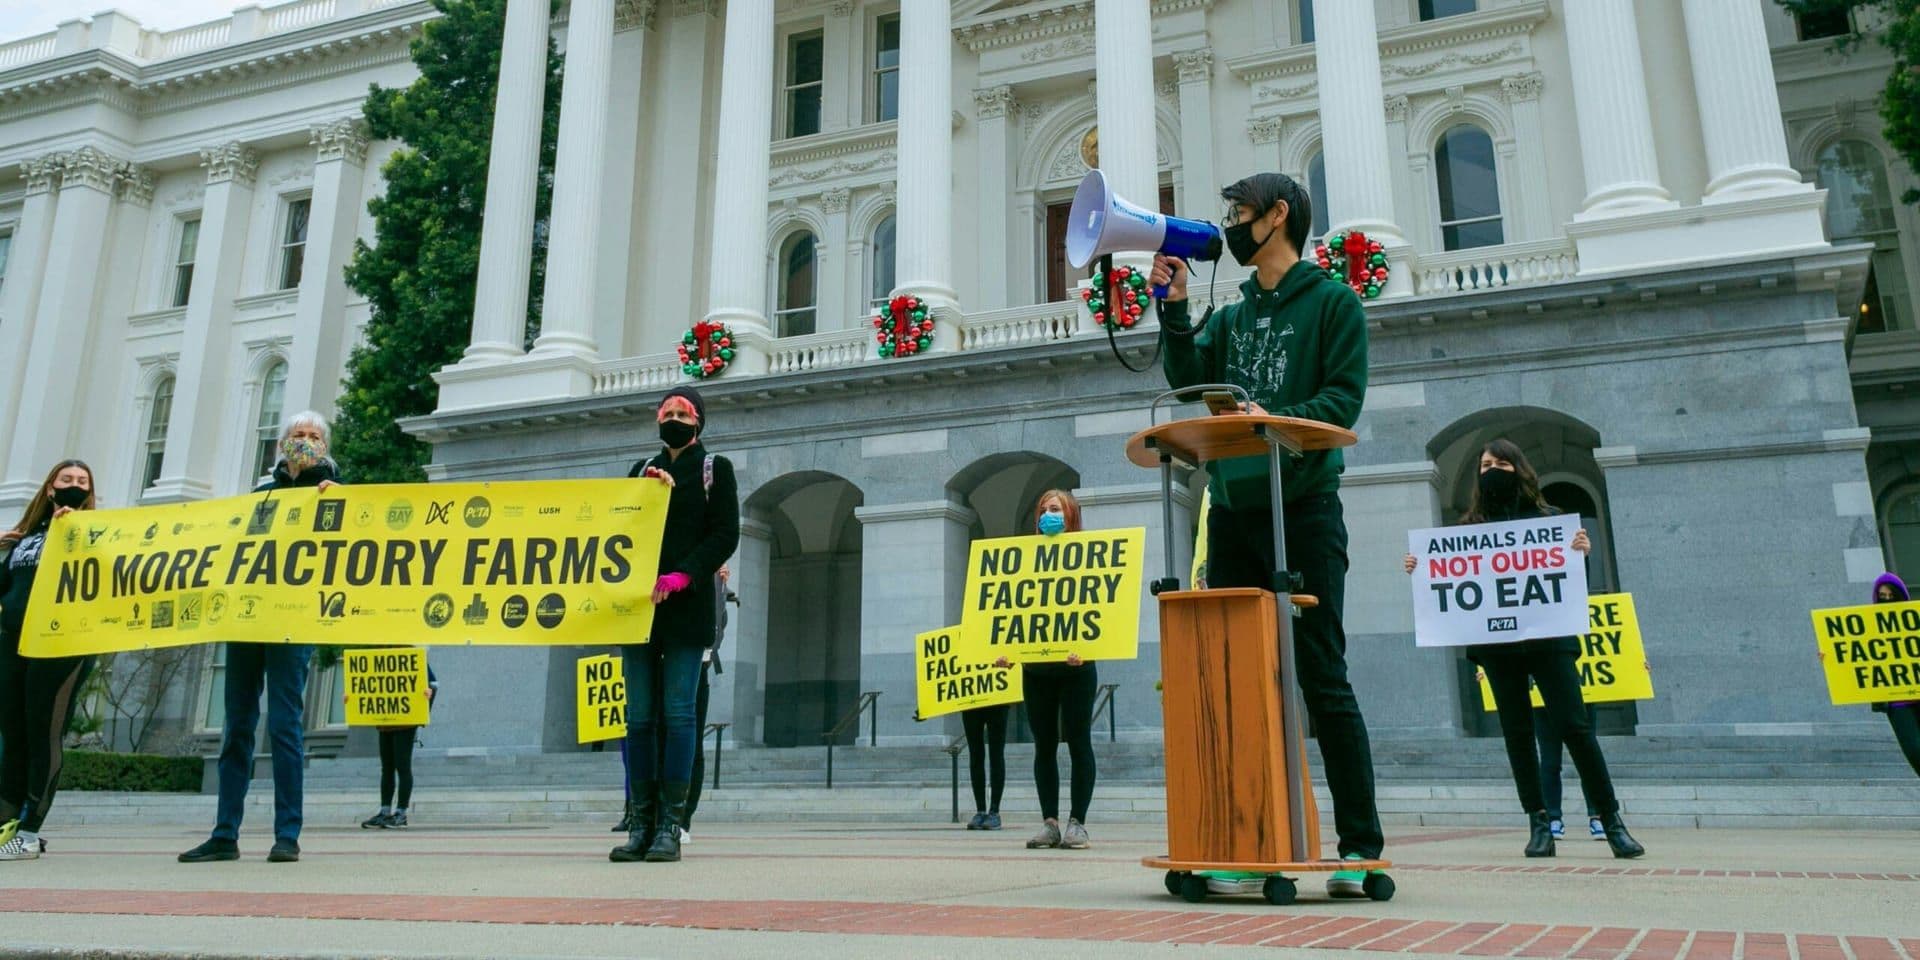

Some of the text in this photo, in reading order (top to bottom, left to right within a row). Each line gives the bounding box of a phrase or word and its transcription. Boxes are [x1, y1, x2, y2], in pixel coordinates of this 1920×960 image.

[538, 506, 561, 515] LUSH
[1427, 526, 1564, 554] ANIMALS ARE
[55, 534, 633, 604] NO MORE FACTORY FARMS
[980, 539, 1129, 577] NO MORE
[1429, 547, 1566, 578] NOT OURS
[978, 573, 1123, 611] FACTORY
[1430, 572, 1567, 613] TO EAT
[990, 610, 1101, 645] FARMS
[1825, 609, 1920, 638] NO MO
[924, 634, 950, 658] NO
[1584, 631, 1621, 656] RY
[1834, 635, 1920, 664] FACTO
[349, 654, 419, 673] NO MORE
[586, 661, 613, 683] NO
[351, 674, 417, 694] FACTORY
[937, 671, 1009, 702] FARMS
[359, 696, 411, 714] FARMS
